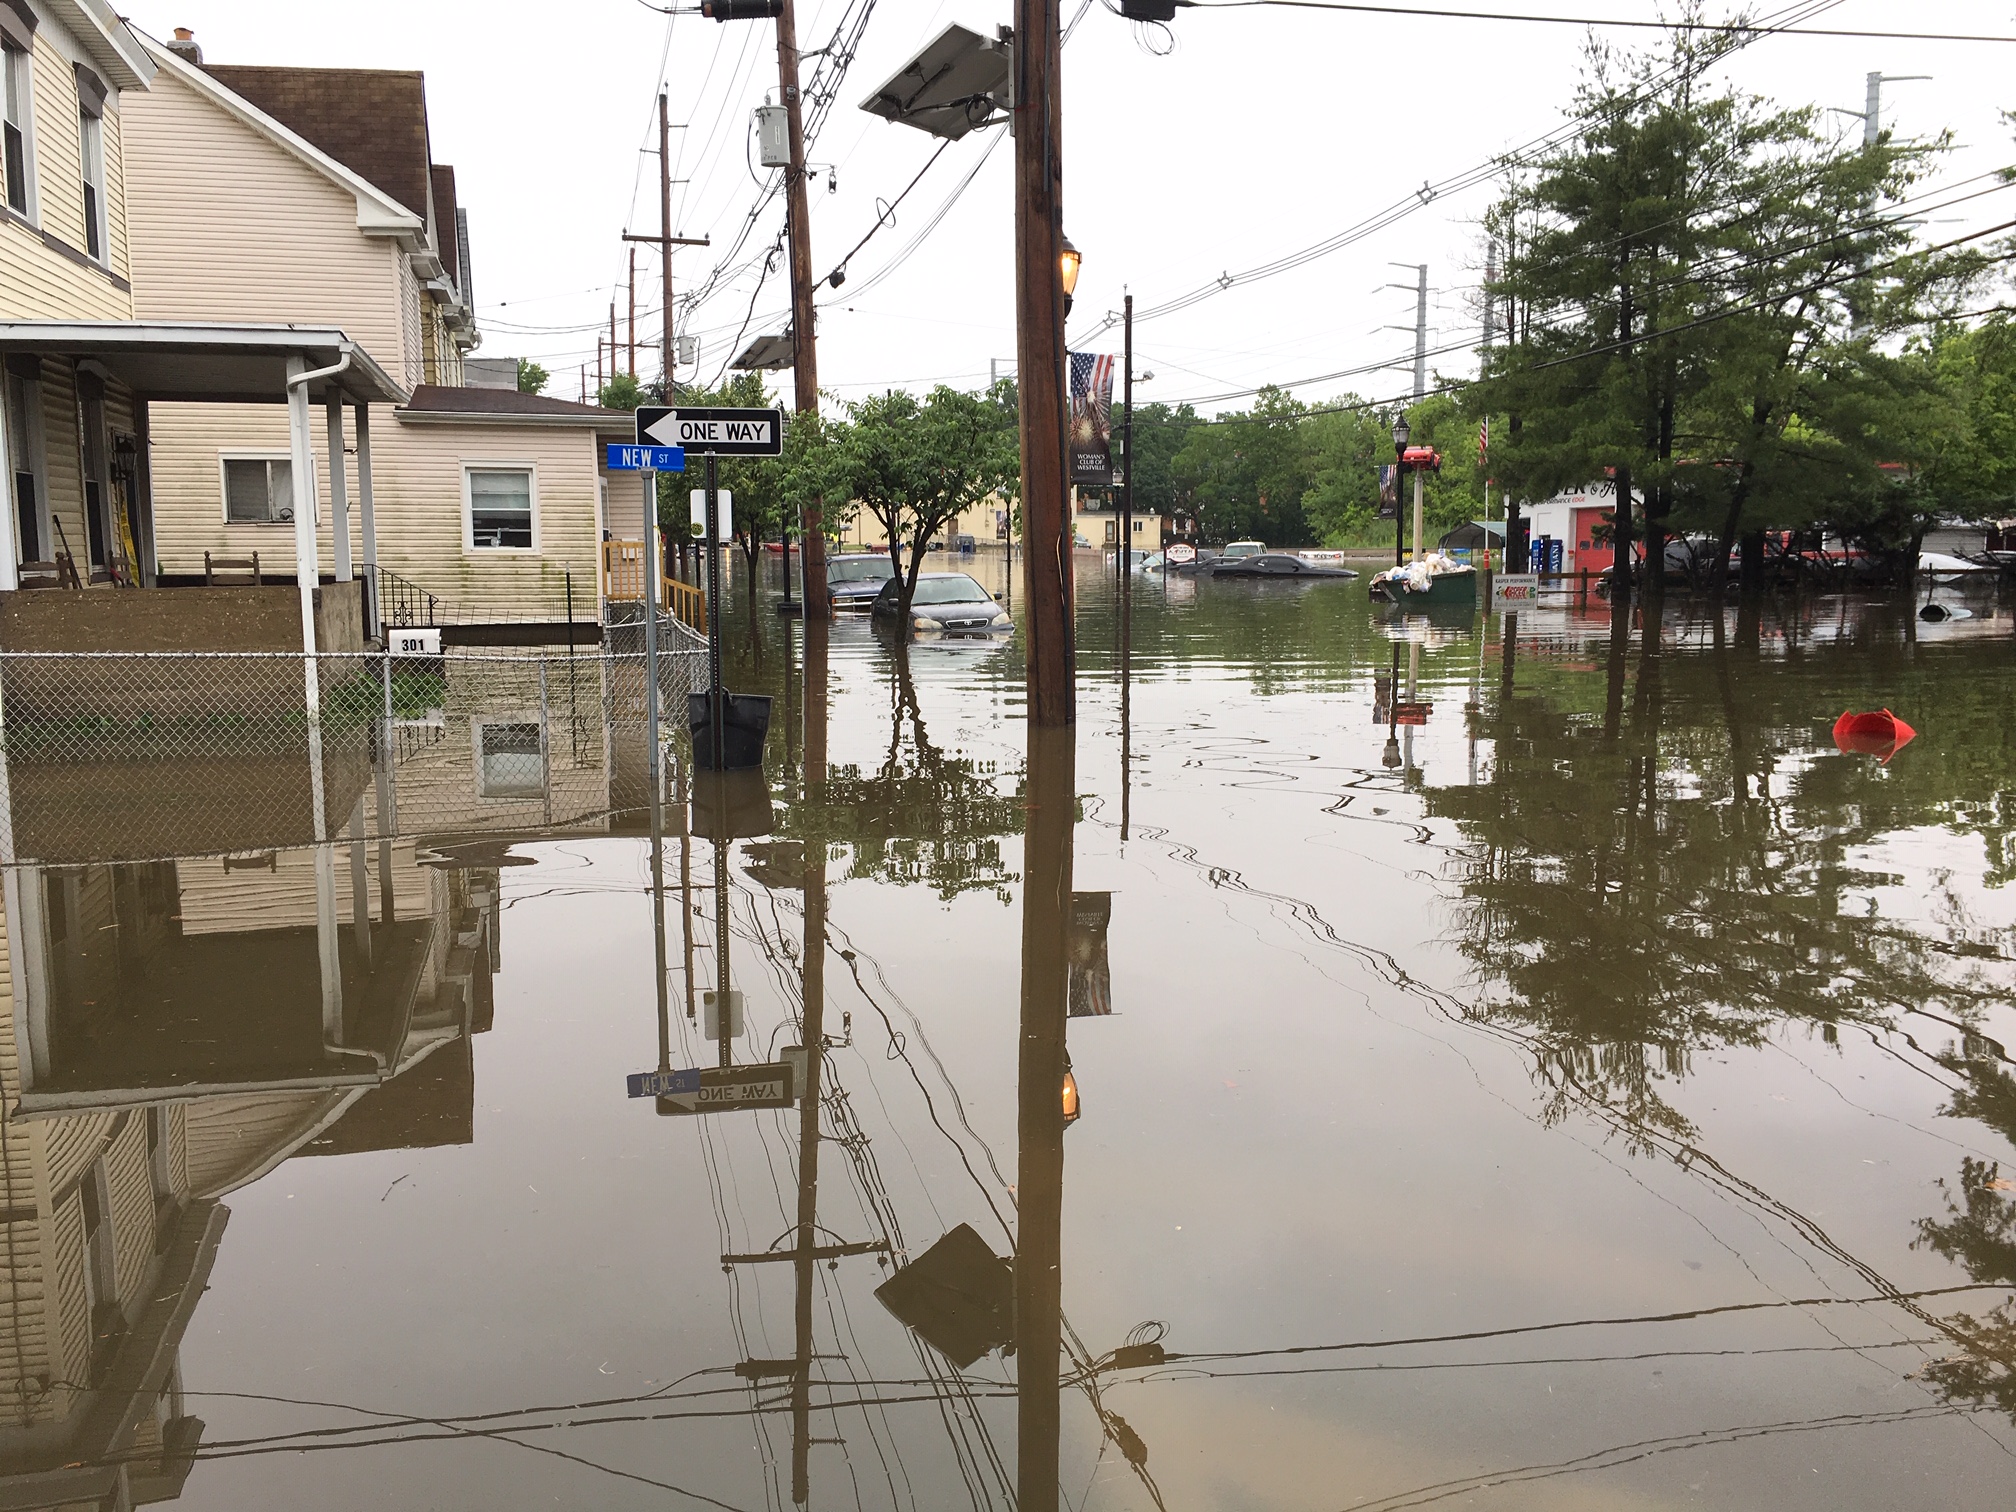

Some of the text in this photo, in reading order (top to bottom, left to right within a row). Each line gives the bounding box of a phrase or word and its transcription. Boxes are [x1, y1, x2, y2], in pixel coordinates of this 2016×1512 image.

[680, 422, 765, 441] ONE WAY
[622, 448, 669, 467] NEW ST
[1537, 497, 1571, 505] FORMANCE
[1551, 544, 1560, 573] ASANI
[402, 639, 425, 652] 301
